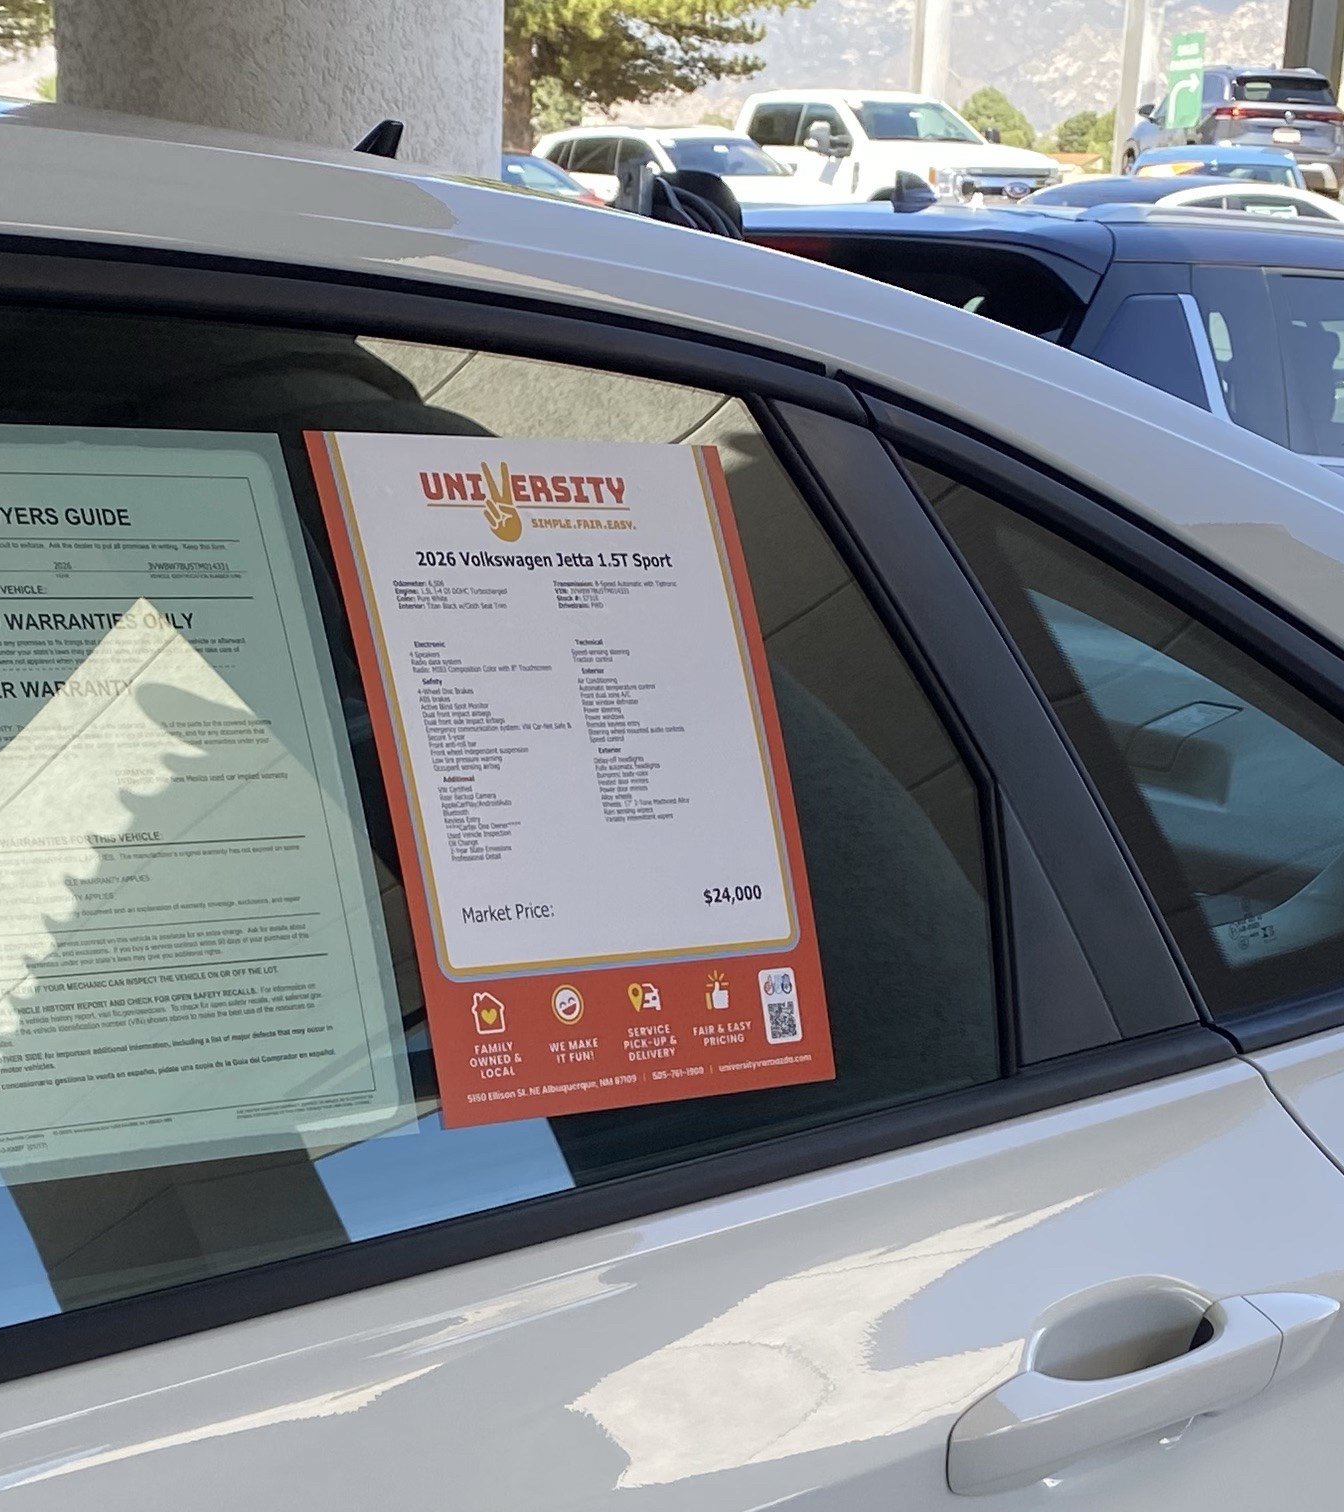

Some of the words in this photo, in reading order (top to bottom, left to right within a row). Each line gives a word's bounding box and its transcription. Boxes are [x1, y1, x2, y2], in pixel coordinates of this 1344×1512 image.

[65, 508, 132, 526] GUIDE
[416, 551, 456, 567] 2026
[459, 552, 553, 570] Volkswagen
[557, 553, 594, 568] Jetta
[599, 553, 628, 568] 1.5T
[632, 554, 673, 571] Sport
[4, 613, 138, 631] WARRANTIES
[143, 613, 193, 630] ONLY
[20, 680, 134, 698] WARRANTY
[703, 884, 762, 908] $24,000
[462, 905, 512, 924] Market
[515, 902, 555, 921] Price:
[43, 983, 65, 992] YOUR
[67, 980, 106, 990] MECHANIC
[109, 979, 125, 987] CAN
[160, 974, 174, 982] THE
[42, 1003, 75, 1012] HISTORY
[110, 999, 125, 1007] AND
[627, 1024, 671, 1037] SERVICE
[693, 1024, 715, 1036] FAIR
[718, 1023, 725, 1034] &
[727, 1021, 752, 1032] EASY
[549, 1042, 565, 1053] WE
[568, 1037, 598, 1050] MAKE
[623, 1036, 667, 1050] PICK-UP
[669, 1035, 677, 1045] &
[704, 1033, 745, 1046] PRICING
[474, 1041, 513, 1055] FAMILY
[629, 1047, 675, 1062] DELIVERY
[469, 1054, 511, 1067] OWNED
[514, 1053, 522, 1063] &
[557, 1054, 566, 1064] IT
[569, 1050, 595, 1062] FUN!
[480, 1066, 516, 1079] LOCAL
[529, 1087, 540, 1096] NE
[599, 1078, 614, 1087] NM
